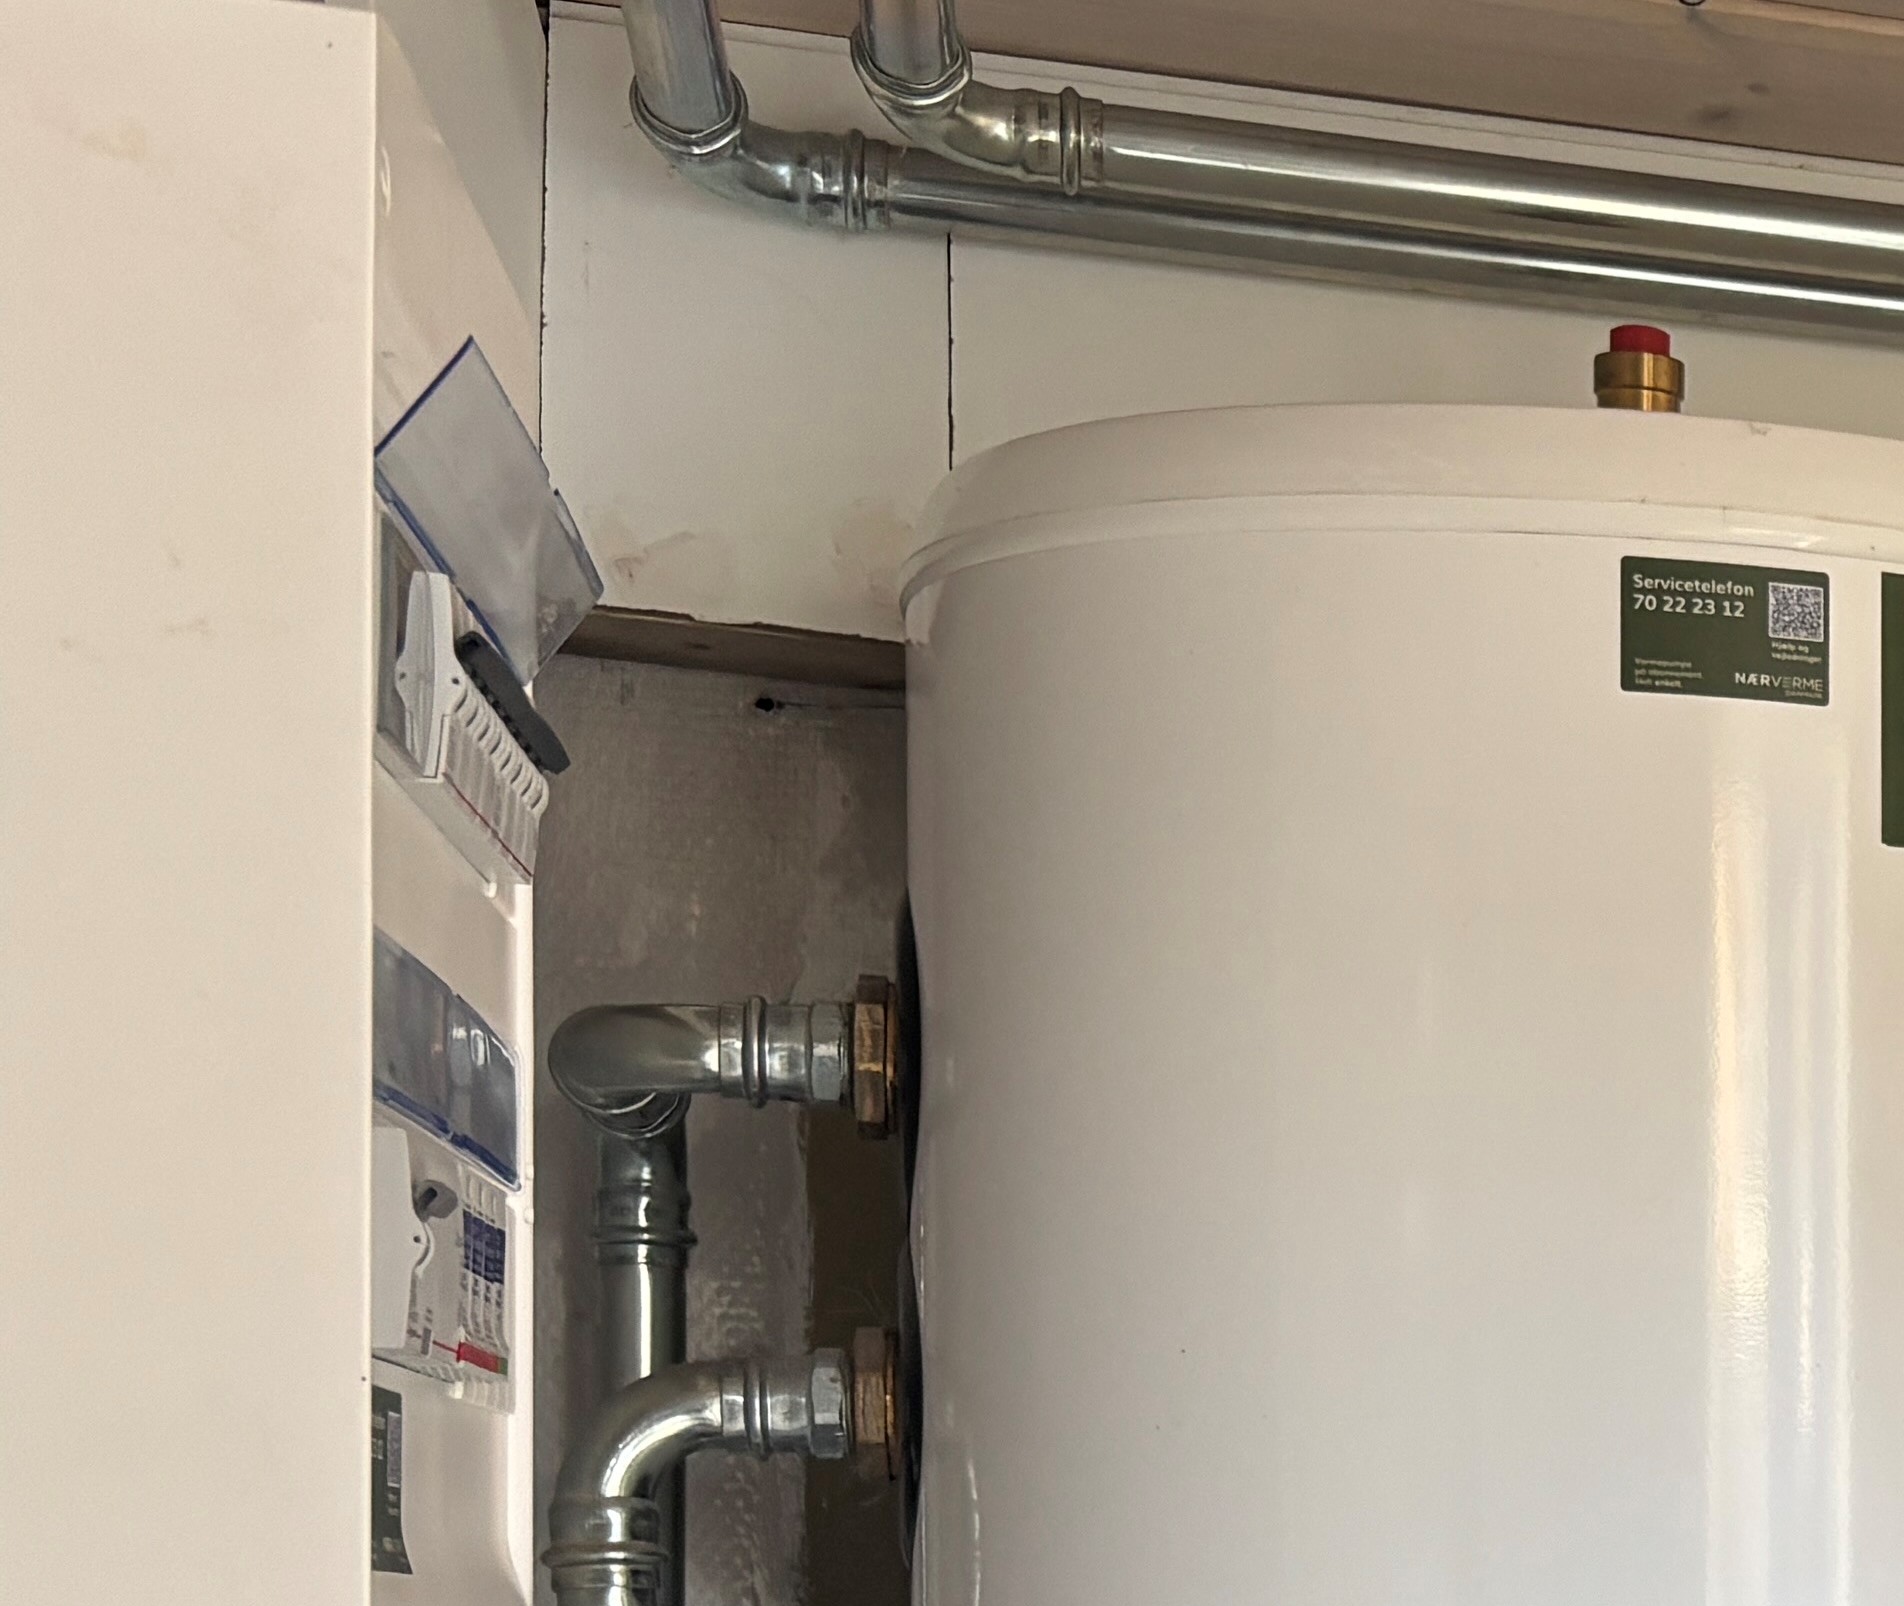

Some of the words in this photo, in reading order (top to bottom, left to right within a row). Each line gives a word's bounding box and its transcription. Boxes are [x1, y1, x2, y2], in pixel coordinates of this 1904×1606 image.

[1632, 573, 1755, 597] Servicetelefon
[1633, 594, 1657, 611] 70
[1663, 596, 1686, 613] 22
[1692, 598, 1716, 615] 23
[1723, 601, 1745, 618] 12
